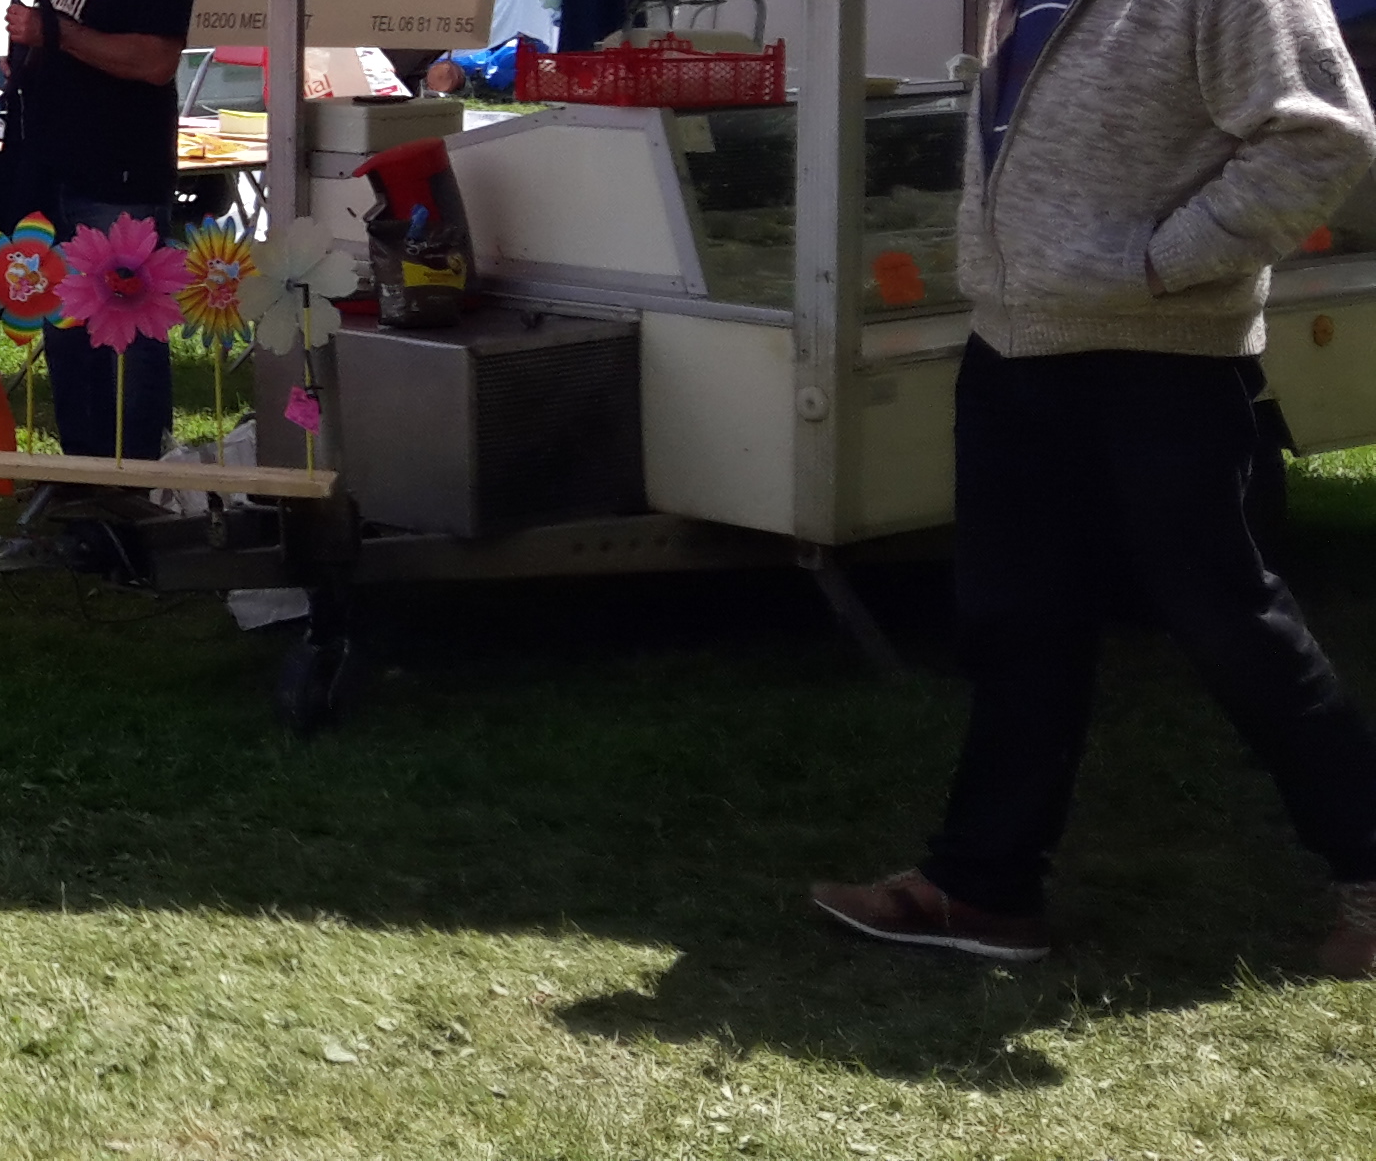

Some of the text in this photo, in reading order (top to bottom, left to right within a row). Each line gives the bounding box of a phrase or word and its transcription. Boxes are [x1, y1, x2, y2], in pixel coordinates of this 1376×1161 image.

[196, 12, 236, 29] 18200
[371, 15, 394, 32] TEL
[398, 16, 415, 32] 06
[416, 17, 432, 33] 81
[436, 17, 452, 33] 78
[454, 18, 474, 34] 55
